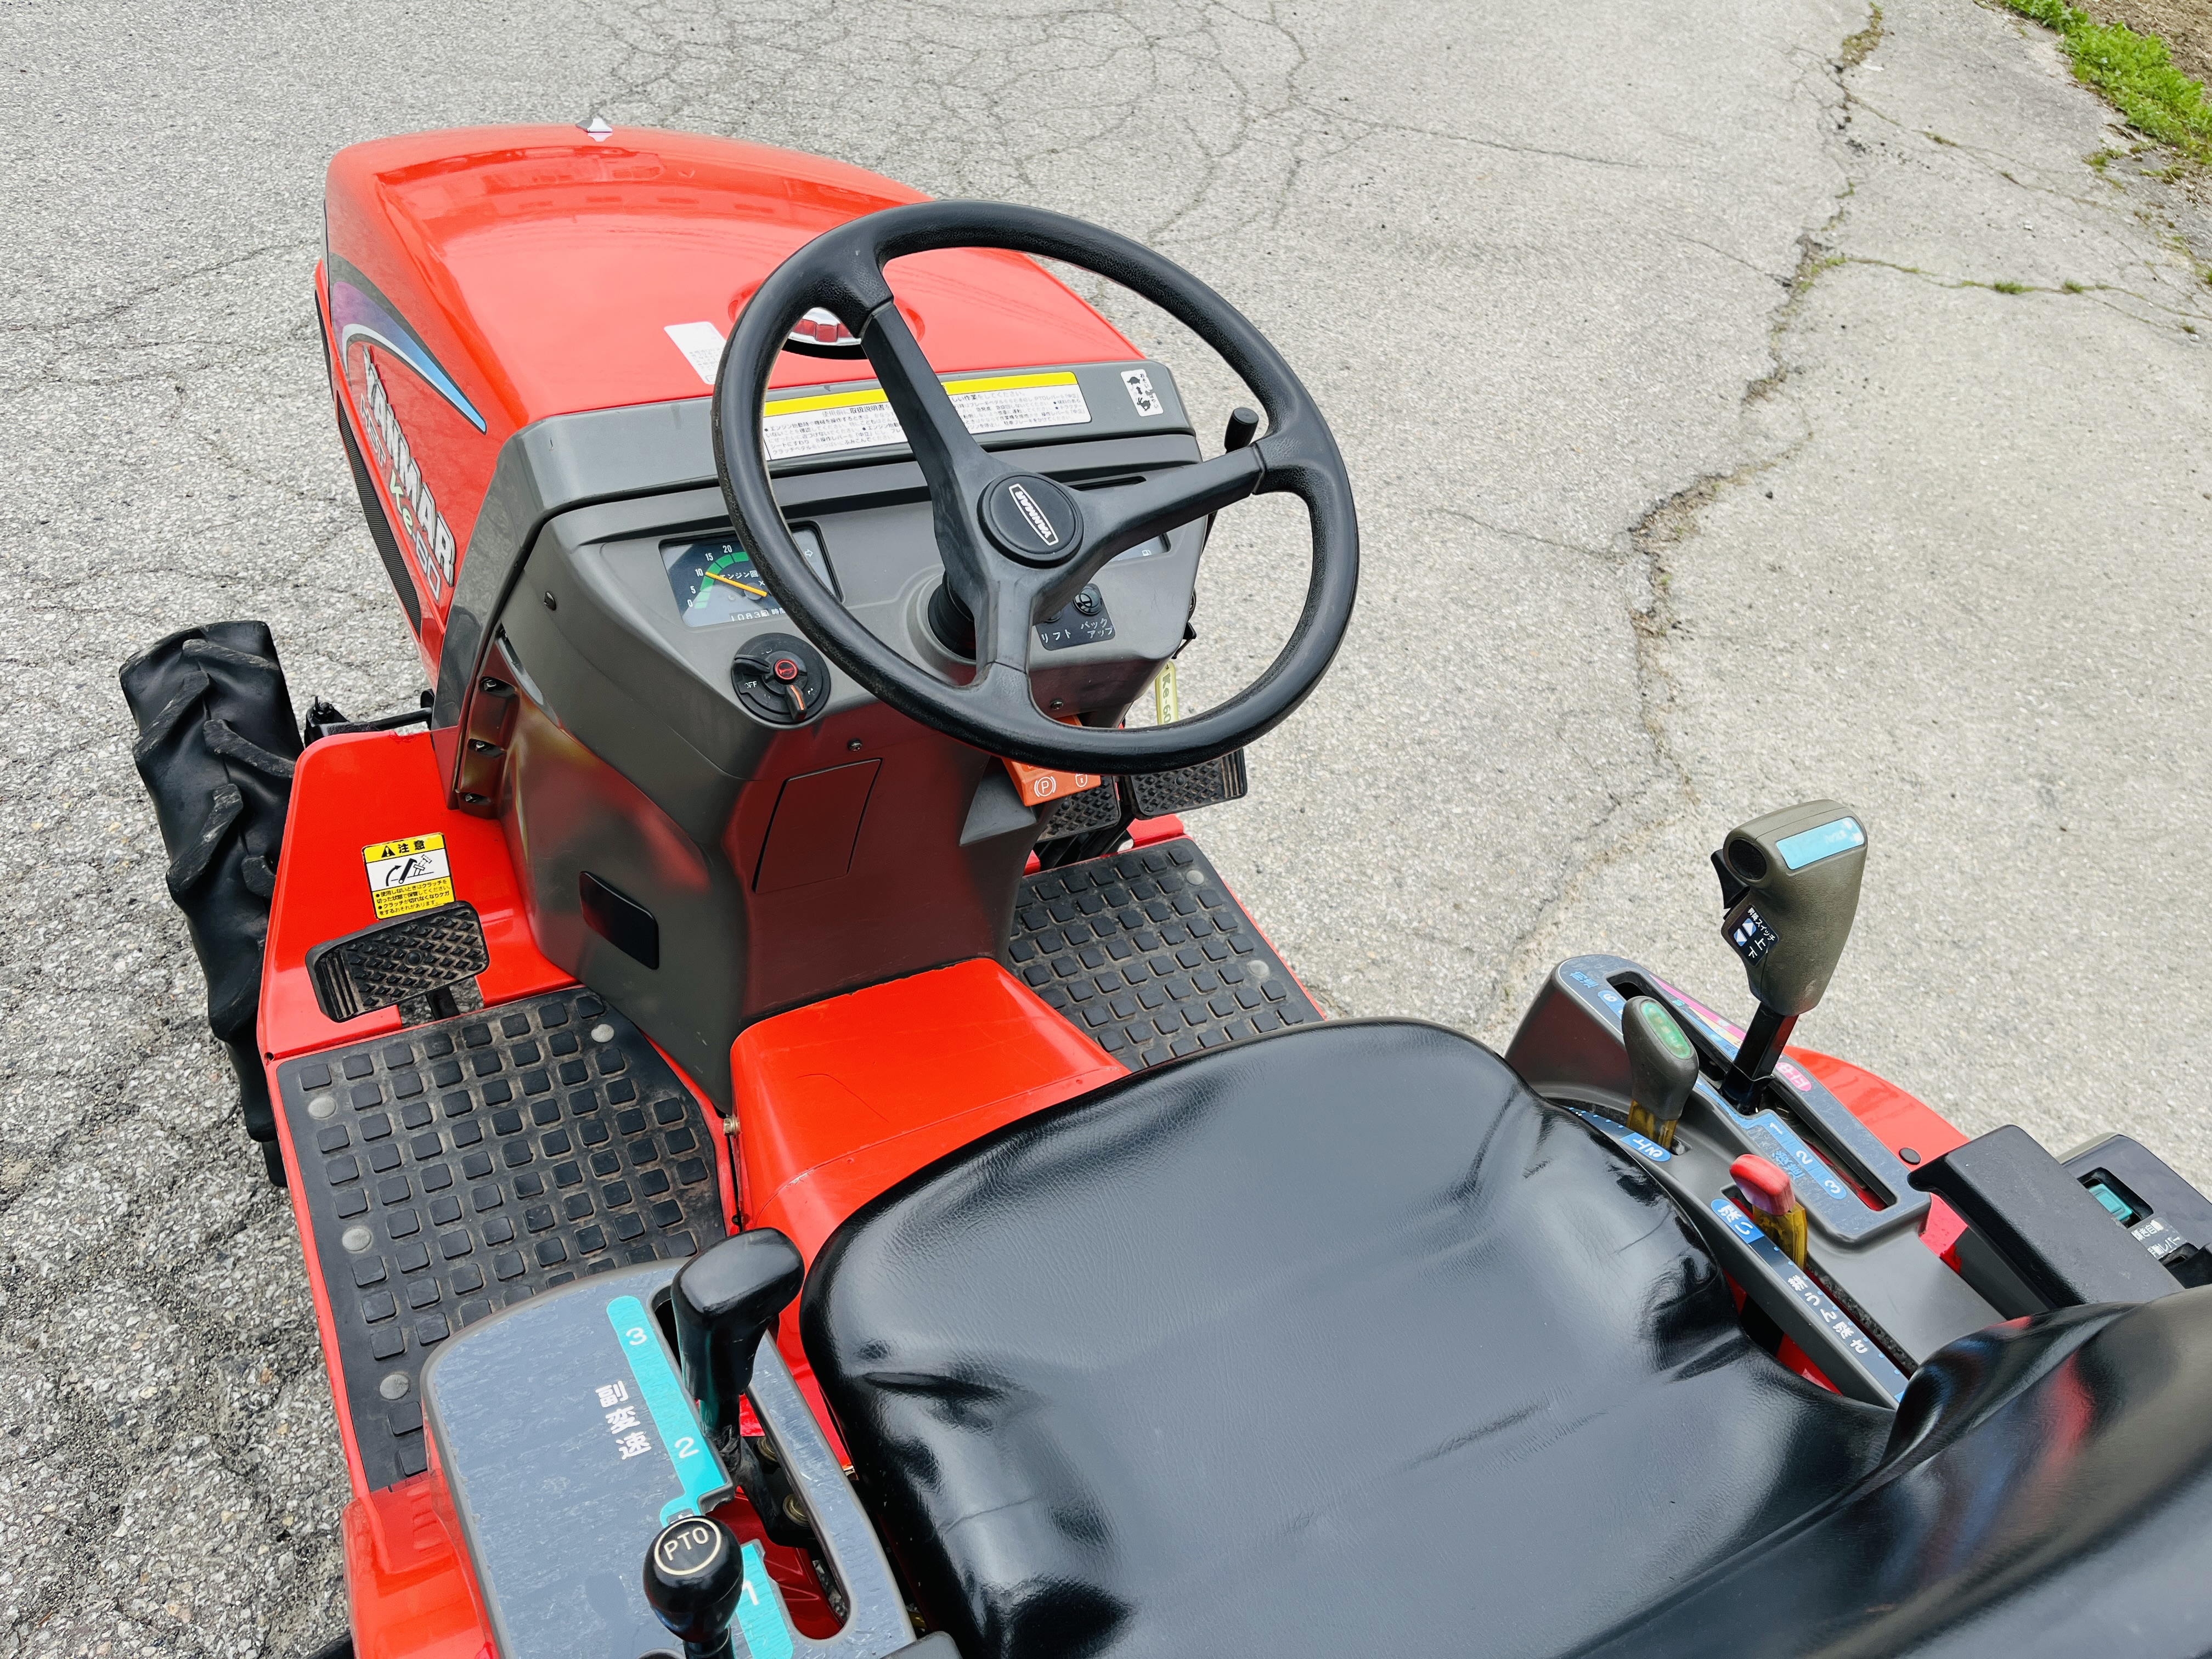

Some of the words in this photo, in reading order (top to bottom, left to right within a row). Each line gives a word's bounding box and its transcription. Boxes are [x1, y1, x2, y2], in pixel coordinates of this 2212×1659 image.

[363, 345, 456, 587] YANMAR
[1014, 490, 1052, 539] YANMAR
[705, 552, 714, 561] 15
[723, 545, 732, 554] 20
[695, 568, 704, 577] 10
[720, 570, 760, 580] エンジン回
[690, 585, 696, 594] 5
[687, 599, 693, 607] 0
[1041, 629, 1072, 643] リフト
[398, 840, 426, 853] 注意
[1754, 938, 1767, 951] 上
[1748, 947, 1757, 958] 下
[1570, 971, 1599, 988] 前進
[1603, 994, 1617, 1002] 6
[1778, 1064, 1809, 1089] 中立
[1769, 1122, 1783, 1135] 1
[1796, 1150, 1813, 1165] 2
[1772, 1150, 1805, 1181] 後進
[1824, 1180, 1841, 1194] 3
[1717, 1205, 1754, 1236] 深い
[1787, 1275, 1868, 1354] 耕うん深さ
[625, 1327, 647, 1346] 3
[595, 1380, 651, 1460] 副変速
[674, 1436, 698, 1459] 2
[664, 1527, 709, 1561] PTO
[742, 1581, 759, 1606] 1
